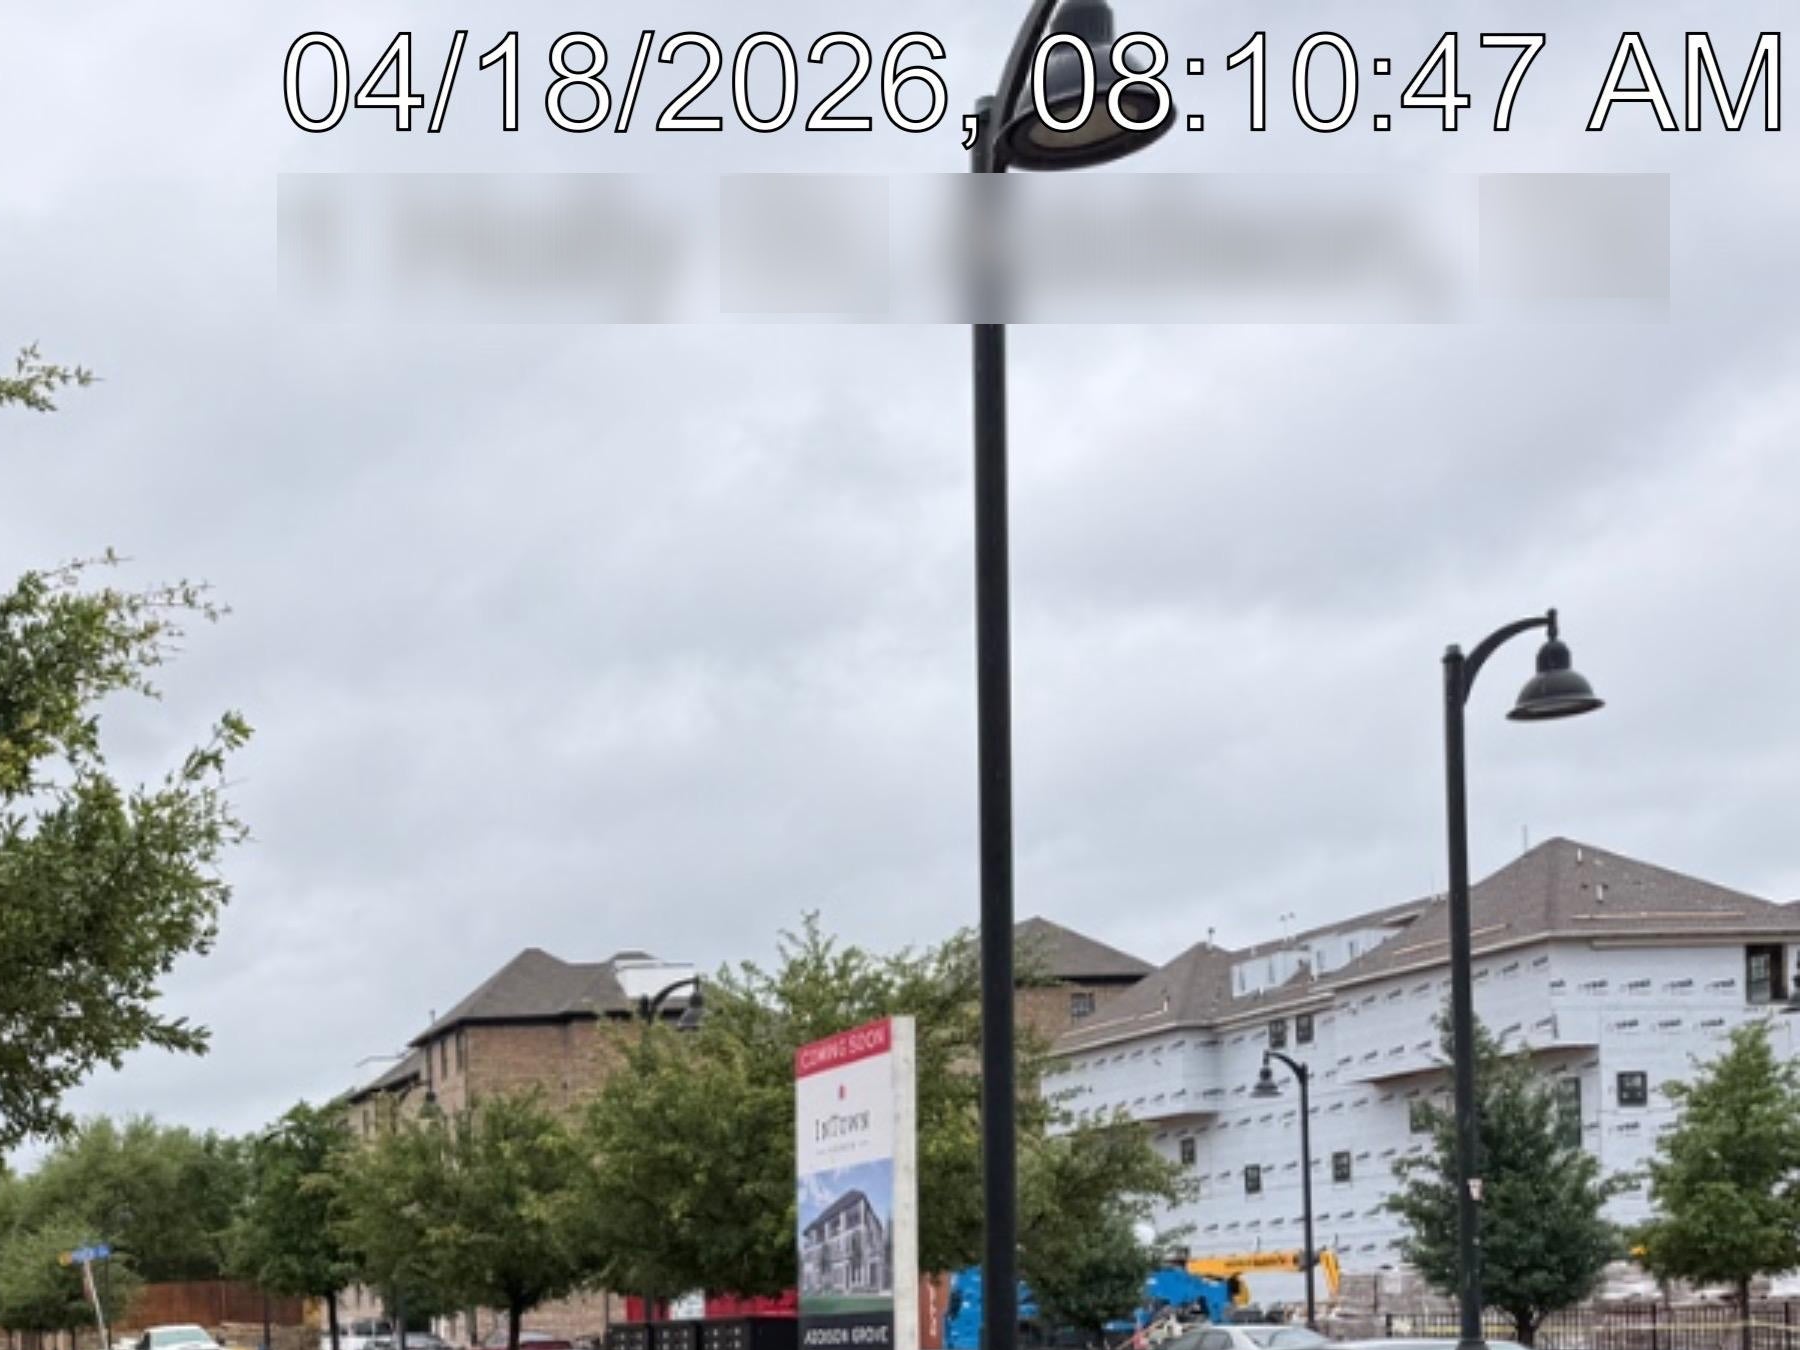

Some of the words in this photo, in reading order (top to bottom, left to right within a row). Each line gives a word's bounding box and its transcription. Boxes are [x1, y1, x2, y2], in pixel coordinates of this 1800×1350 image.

[802, 1040, 847, 1068] COMING
[848, 1029, 884, 1054] SOON
[850, 1324, 889, 1345] GROVE
